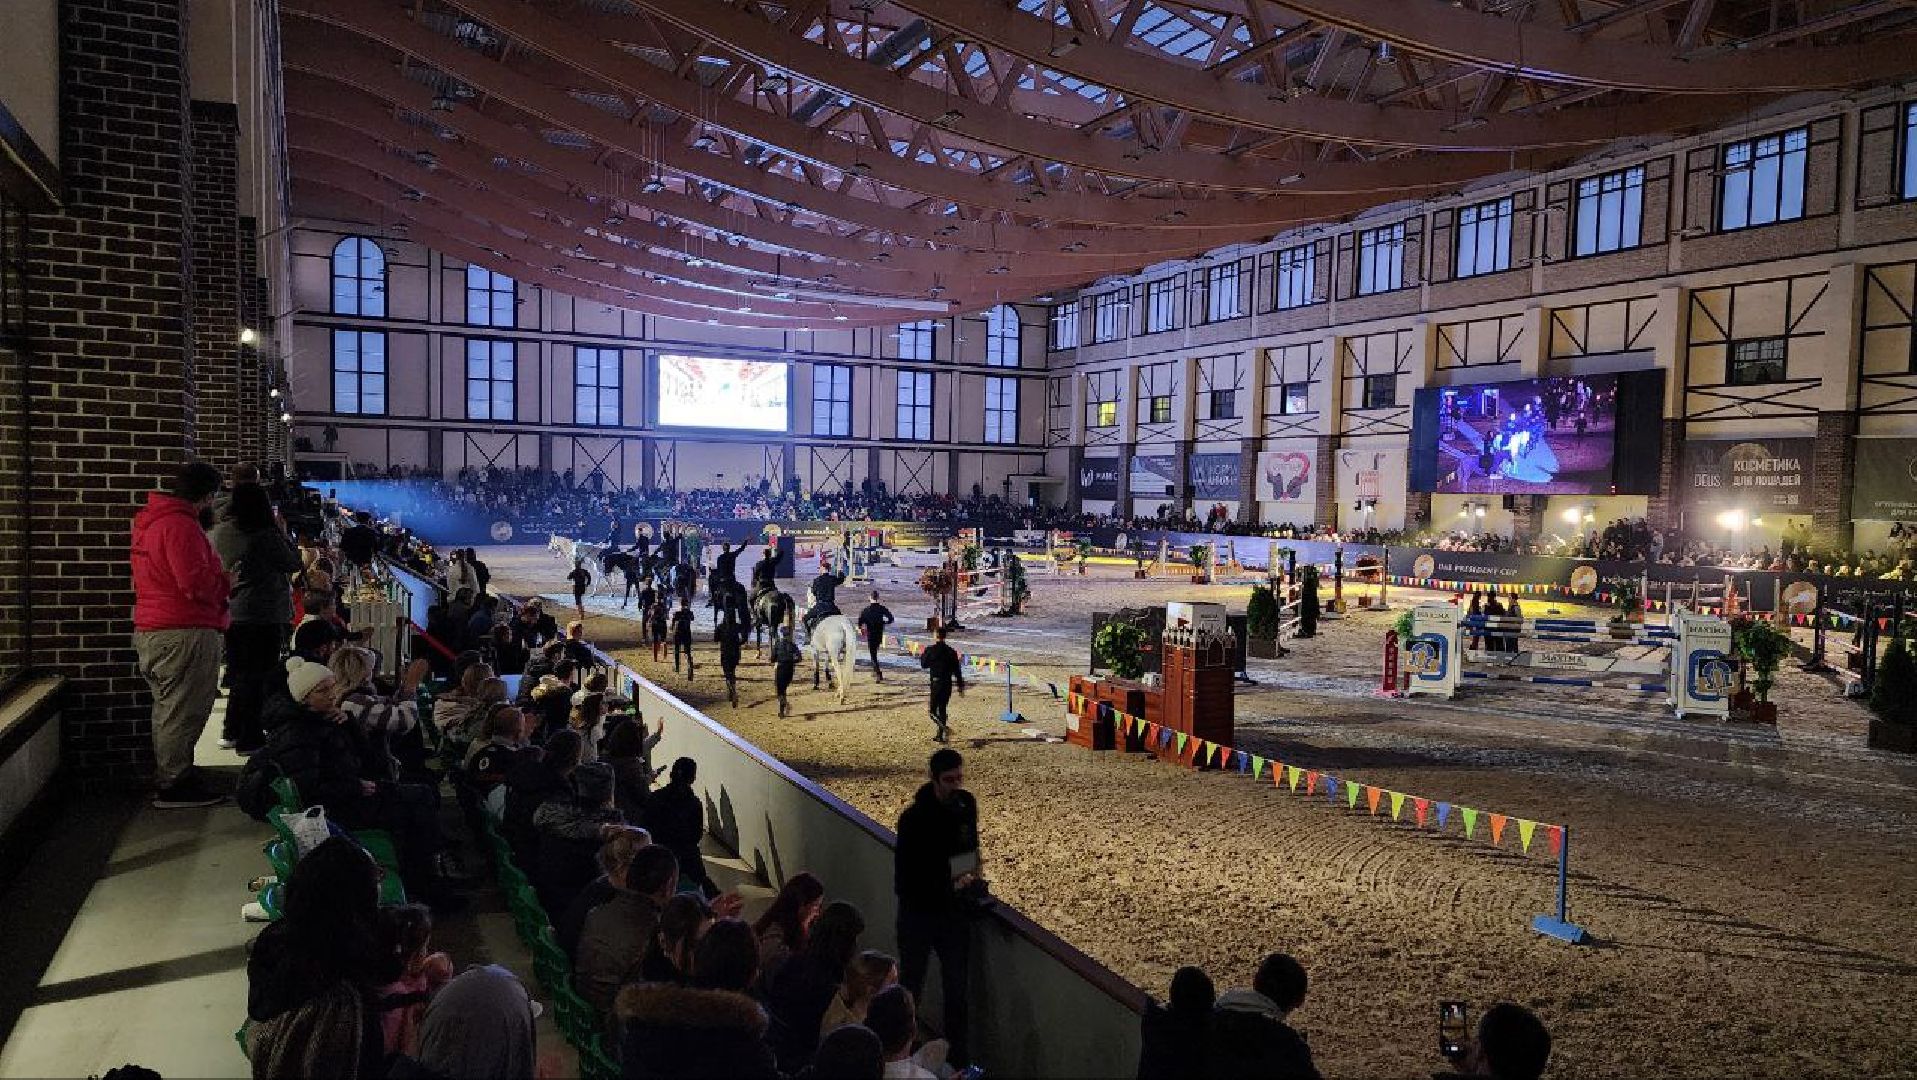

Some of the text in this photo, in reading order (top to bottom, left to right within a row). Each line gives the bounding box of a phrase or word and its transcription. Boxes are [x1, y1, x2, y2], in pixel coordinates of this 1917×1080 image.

[1733, 458, 1801, 472] КОСМЕТИКА
[1733, 473, 1801, 486] ДЛЯ ЛОШАДЕЙ
[1454, 565, 1499, 575] PRESIDENT
[1499, 568, 1518, 577] CUP
[1689, 626, 1728, 634] MAXIMA
[1541, 653, 1584, 664] MAXIMA
